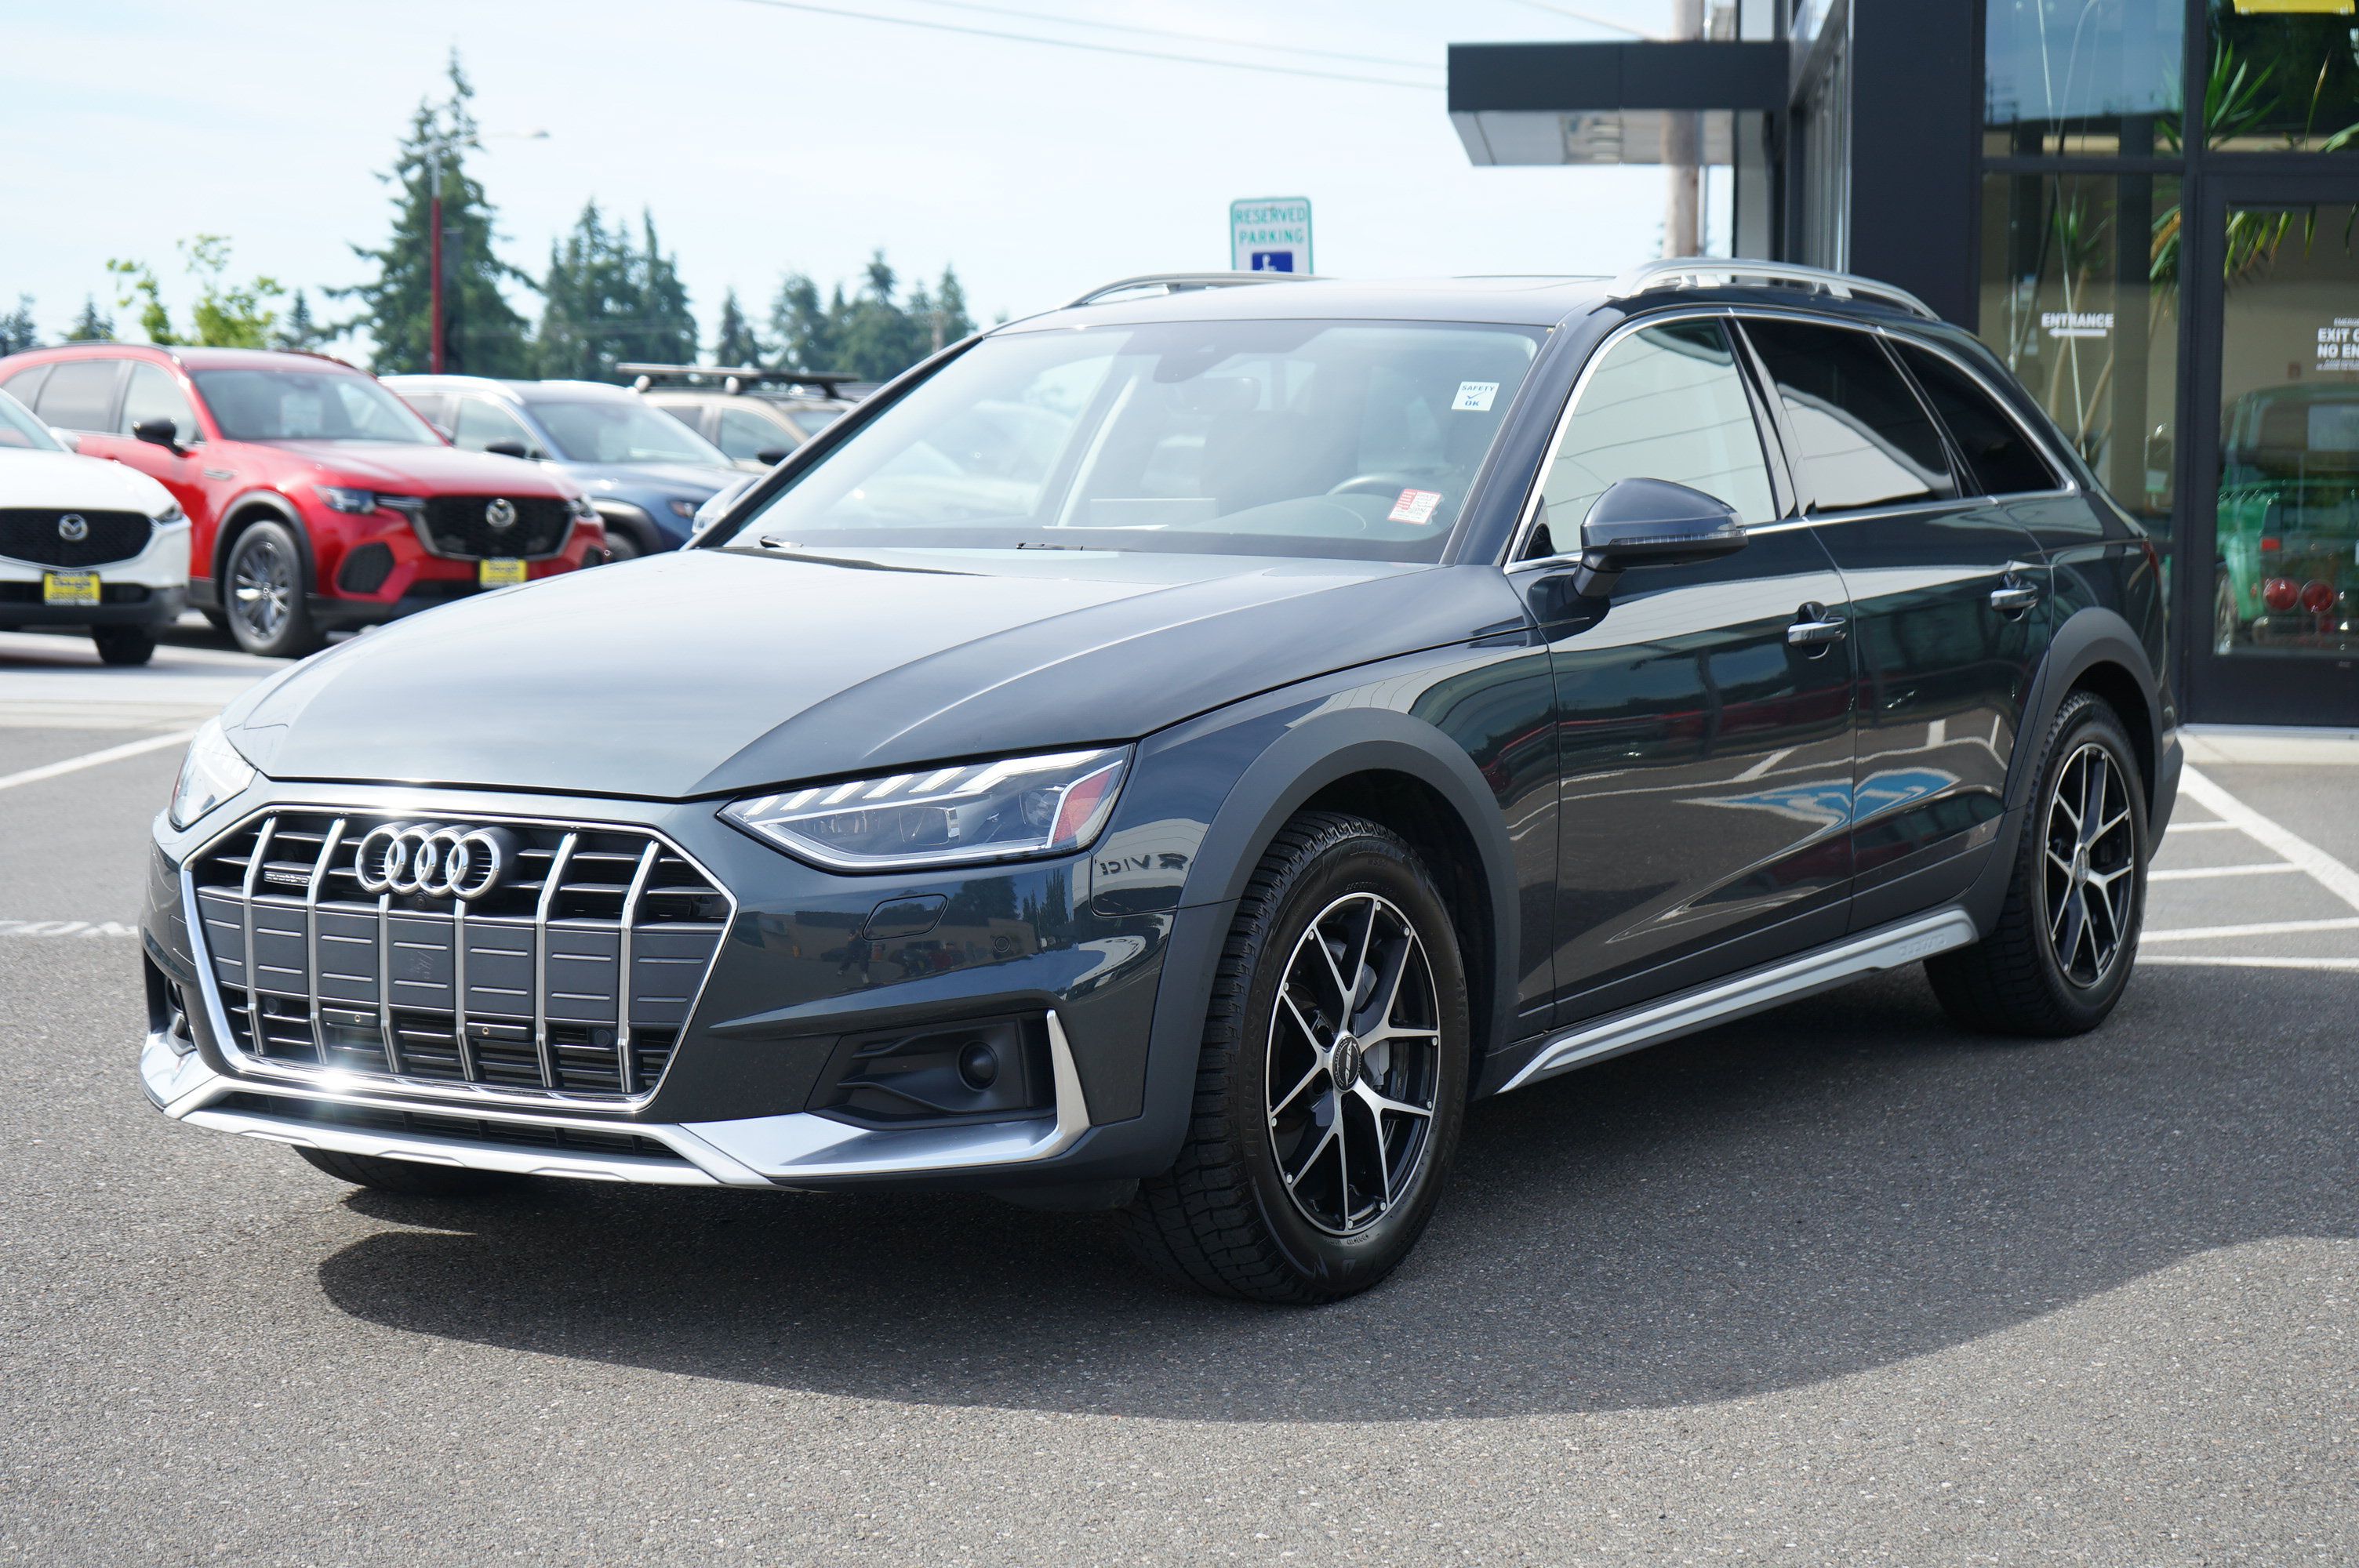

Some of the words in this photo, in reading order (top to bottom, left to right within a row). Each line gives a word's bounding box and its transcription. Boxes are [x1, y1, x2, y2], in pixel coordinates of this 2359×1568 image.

[1235, 207, 1306, 224] RESERVED
[1239, 227, 1304, 245] PARKING
[2041, 312, 2114, 328] ENTRANCE
[2317, 328, 2350, 343] EXIT
[2317, 343, 2339, 358] NO
